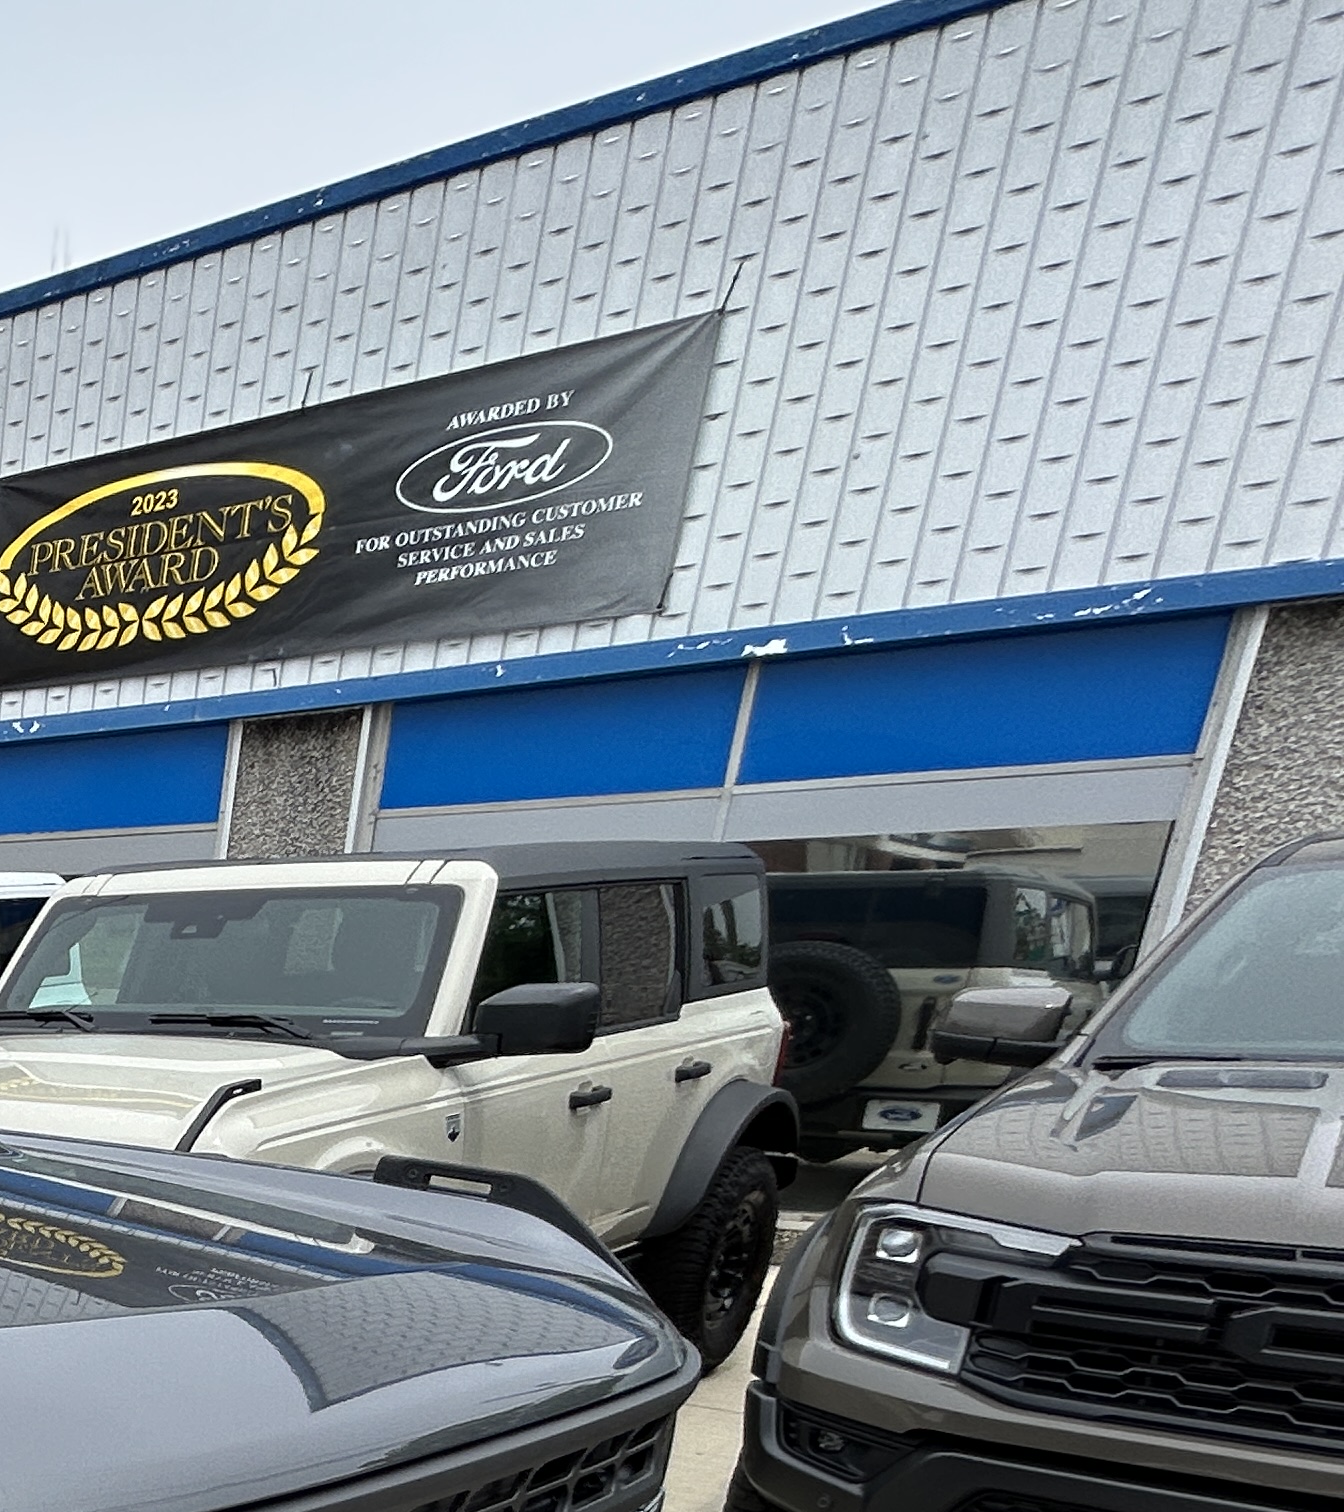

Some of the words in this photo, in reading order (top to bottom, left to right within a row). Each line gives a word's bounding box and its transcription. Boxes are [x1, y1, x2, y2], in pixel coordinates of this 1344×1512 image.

[446, 398, 540, 431] AWARDED
[546, 390, 575, 410] BY
[432, 433, 571, 502] Ford
[130, 488, 179, 516] 2023
[355, 534, 390, 554] FOR
[395, 514, 526, 547] OUTSTANDING
[531, 492, 643, 525] CUSTOMER
[27, 494, 294, 577] PRESIDENT'S
[397, 543, 475, 568] SERVICE
[479, 536, 520, 556] AND
[523, 524, 586, 547] SALES
[74, 548, 220, 601] AWARD
[414, 550, 558, 586] PERFORMANCE
